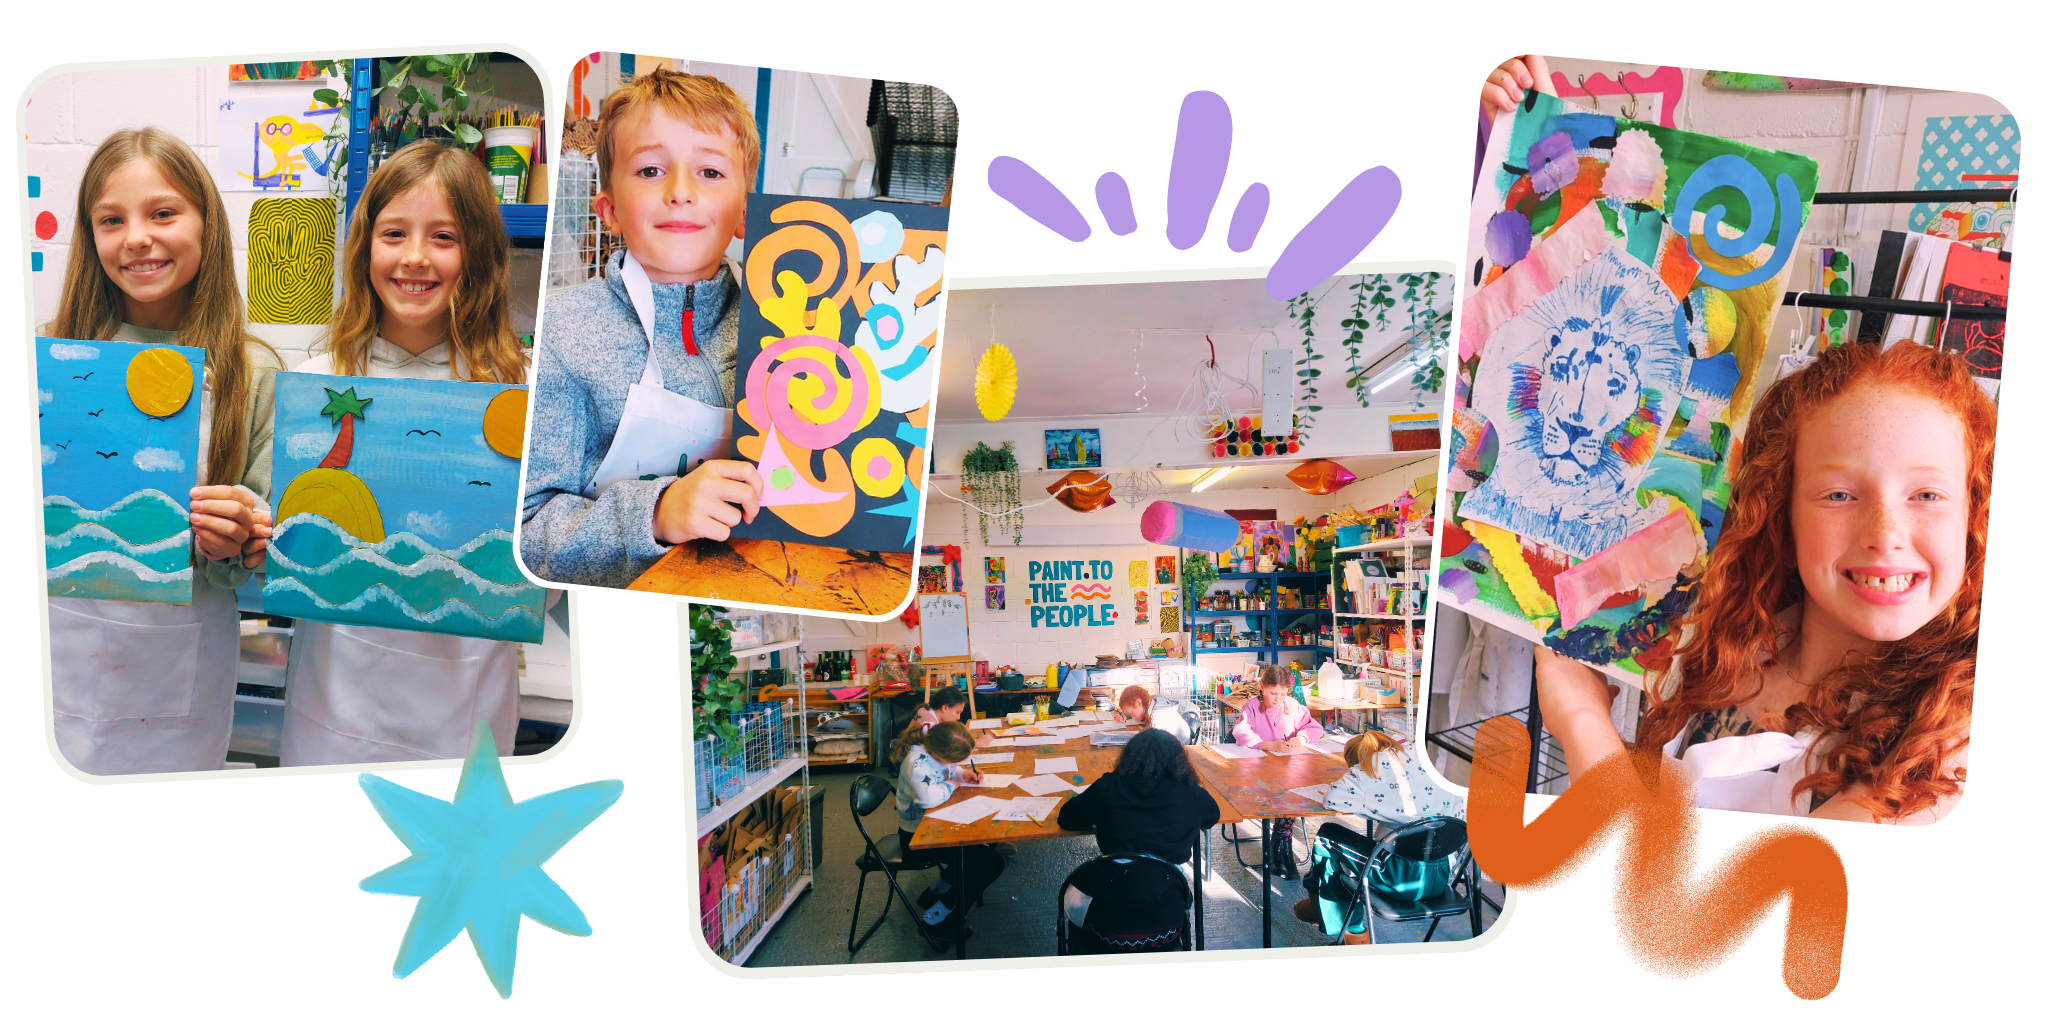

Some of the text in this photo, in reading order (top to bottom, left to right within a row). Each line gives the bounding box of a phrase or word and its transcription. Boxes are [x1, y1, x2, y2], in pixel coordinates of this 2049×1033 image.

[1029, 560, 1113, 581] PAINT TO
[1029, 583, 1067, 603] THE
[1031, 604, 1115, 628] PEOPLE
